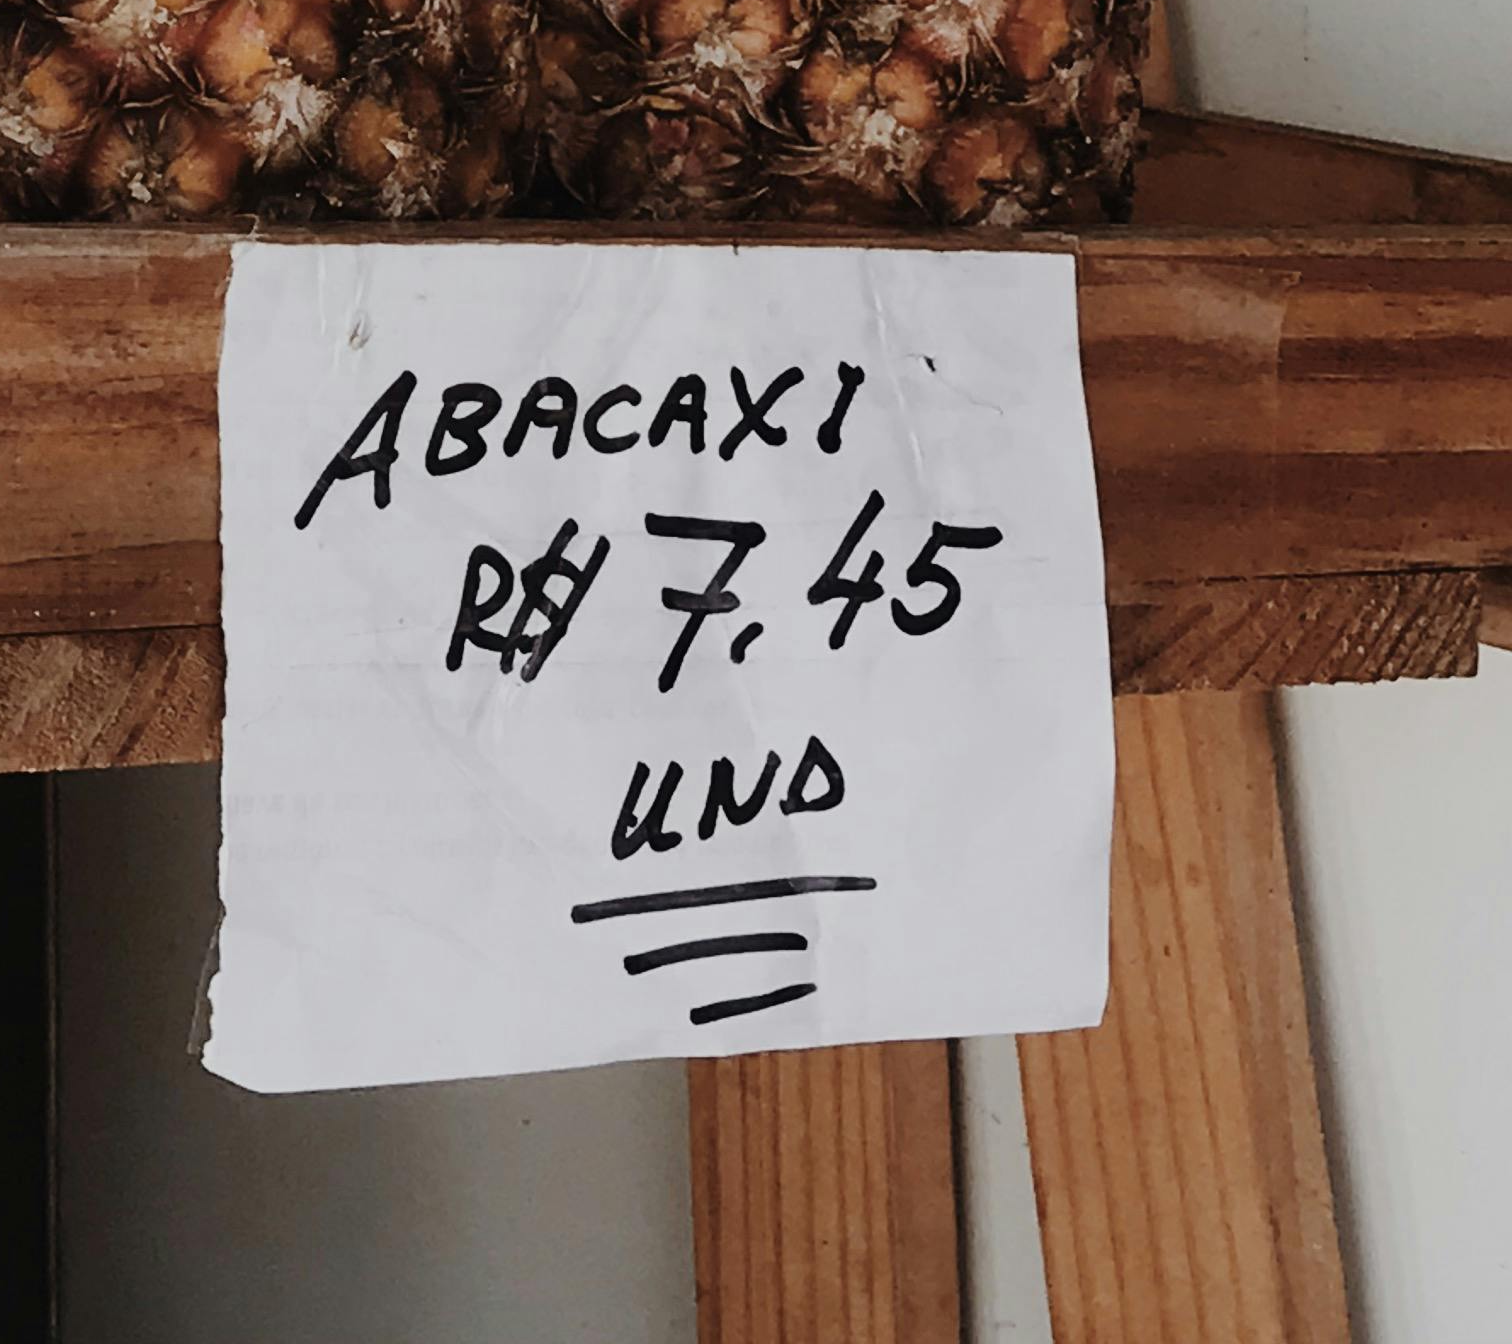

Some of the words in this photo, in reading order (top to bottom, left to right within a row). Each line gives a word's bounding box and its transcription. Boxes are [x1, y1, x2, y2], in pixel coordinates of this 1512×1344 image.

[293, 360, 866, 531] ABACAXI
[445, 518, 611, 683] R$
[610, 735, 846, 861] UND
